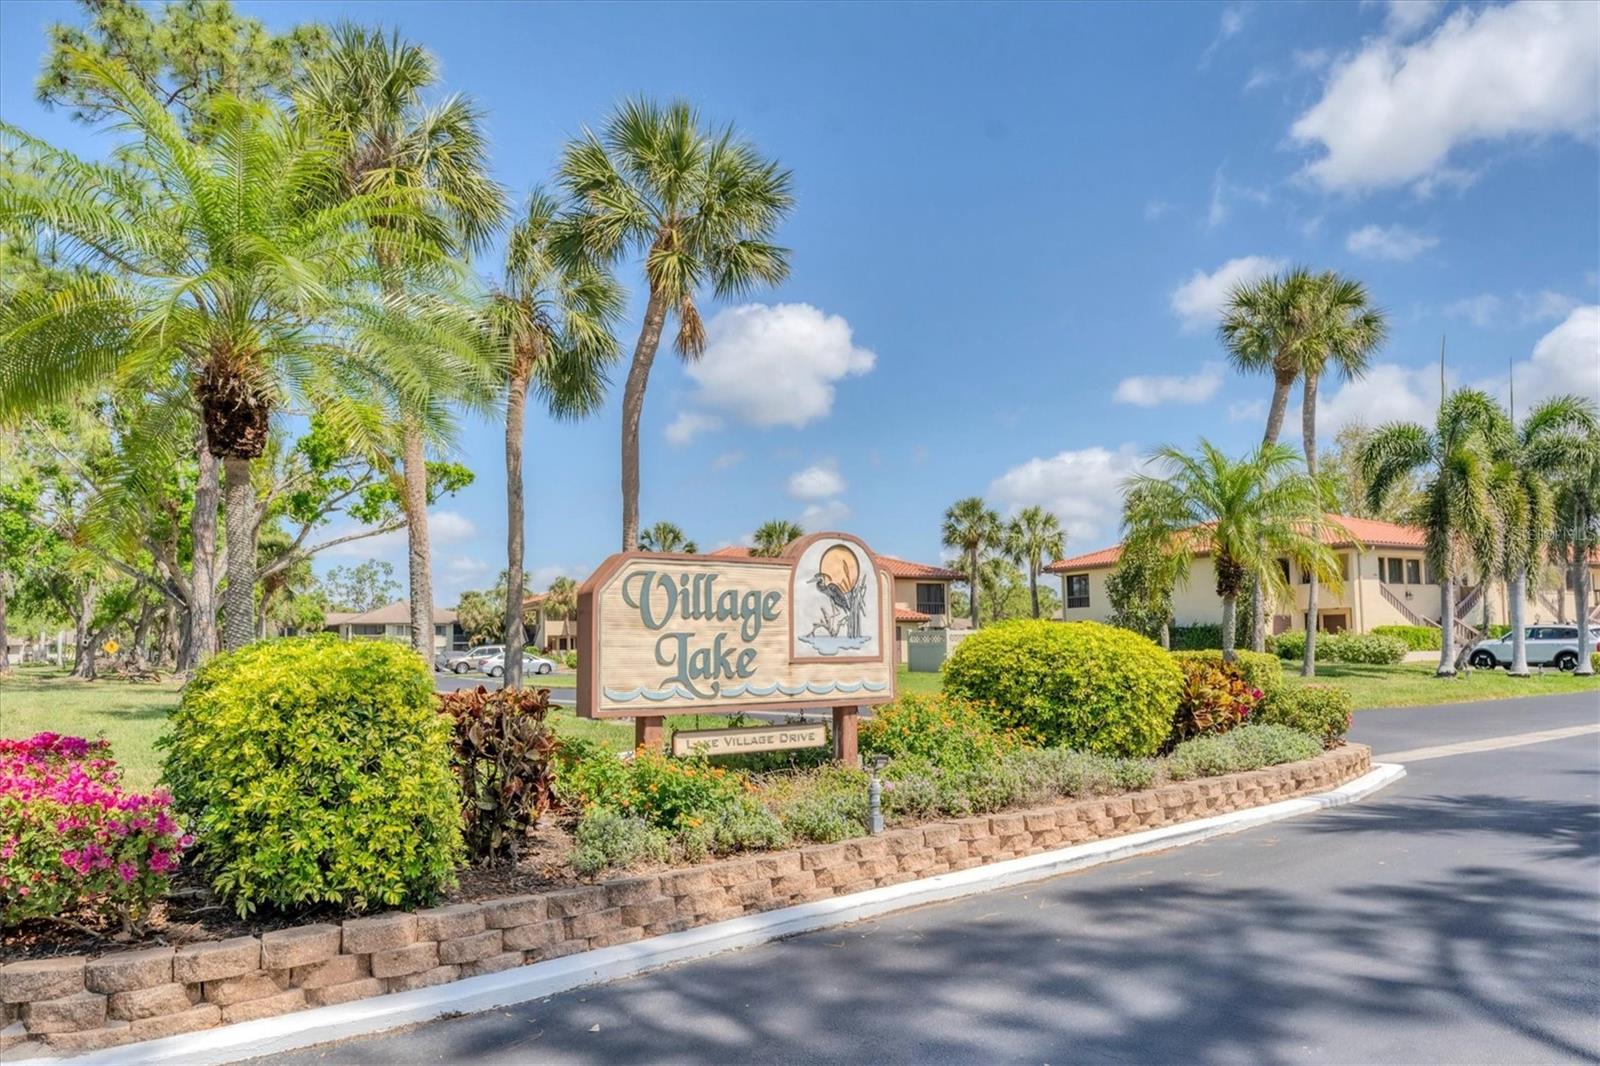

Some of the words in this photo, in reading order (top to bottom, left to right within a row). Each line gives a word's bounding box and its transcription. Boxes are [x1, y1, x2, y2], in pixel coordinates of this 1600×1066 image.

[622, 570, 782, 642] Village
[655, 632, 758, 699] Lake
[686, 738, 719, 750] LKE
[723, 734, 775, 746] VILLAGE
[779, 732, 816, 743] DRIVE
